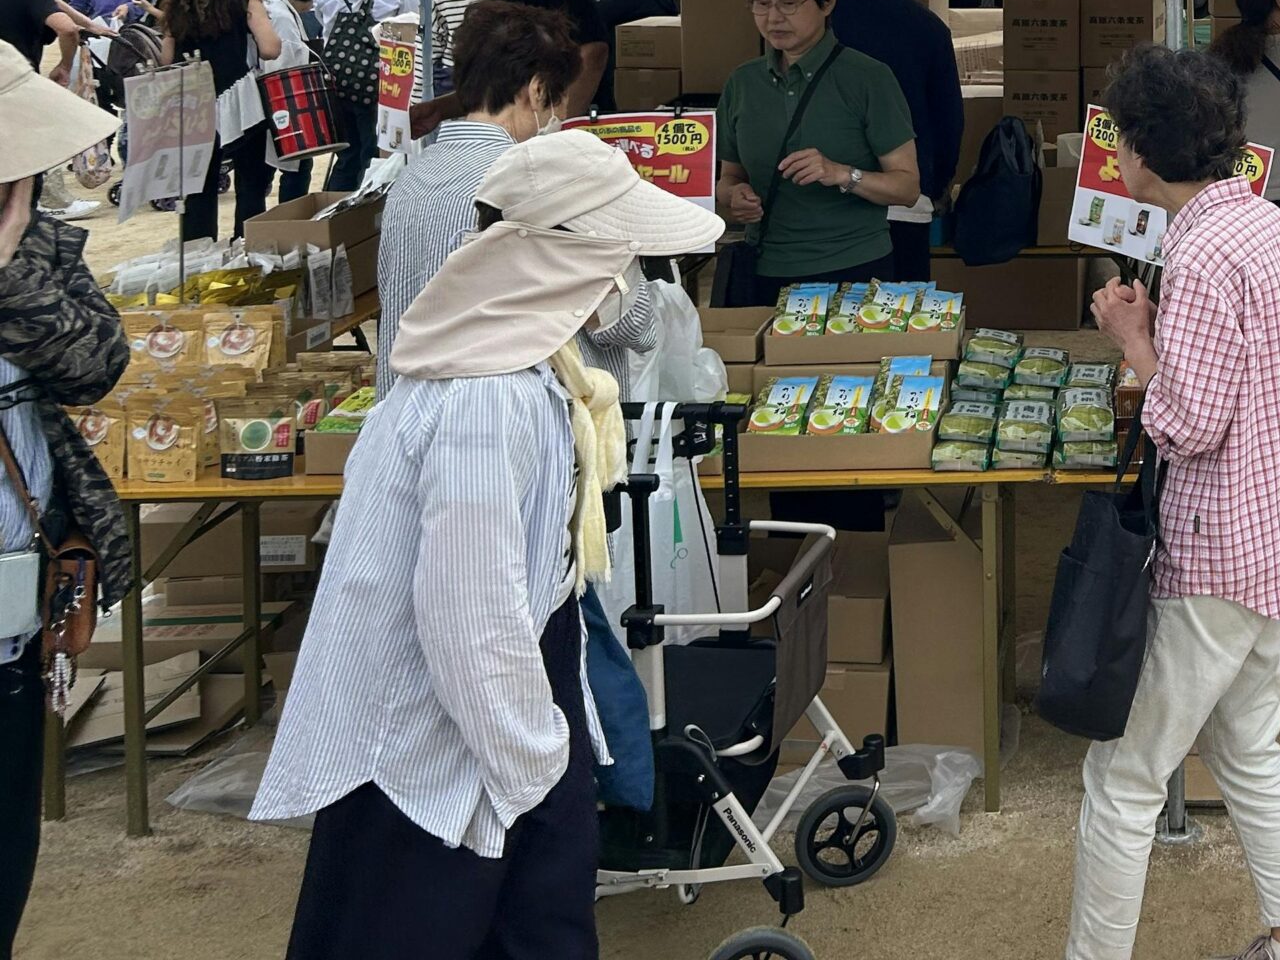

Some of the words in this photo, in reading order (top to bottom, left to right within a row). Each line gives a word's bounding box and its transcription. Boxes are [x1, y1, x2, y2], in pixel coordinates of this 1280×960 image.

[662, 123, 696, 134] 4個で
[657, 134, 703, 145] 1500円
[723, 807, 756, 853] Panasonic
